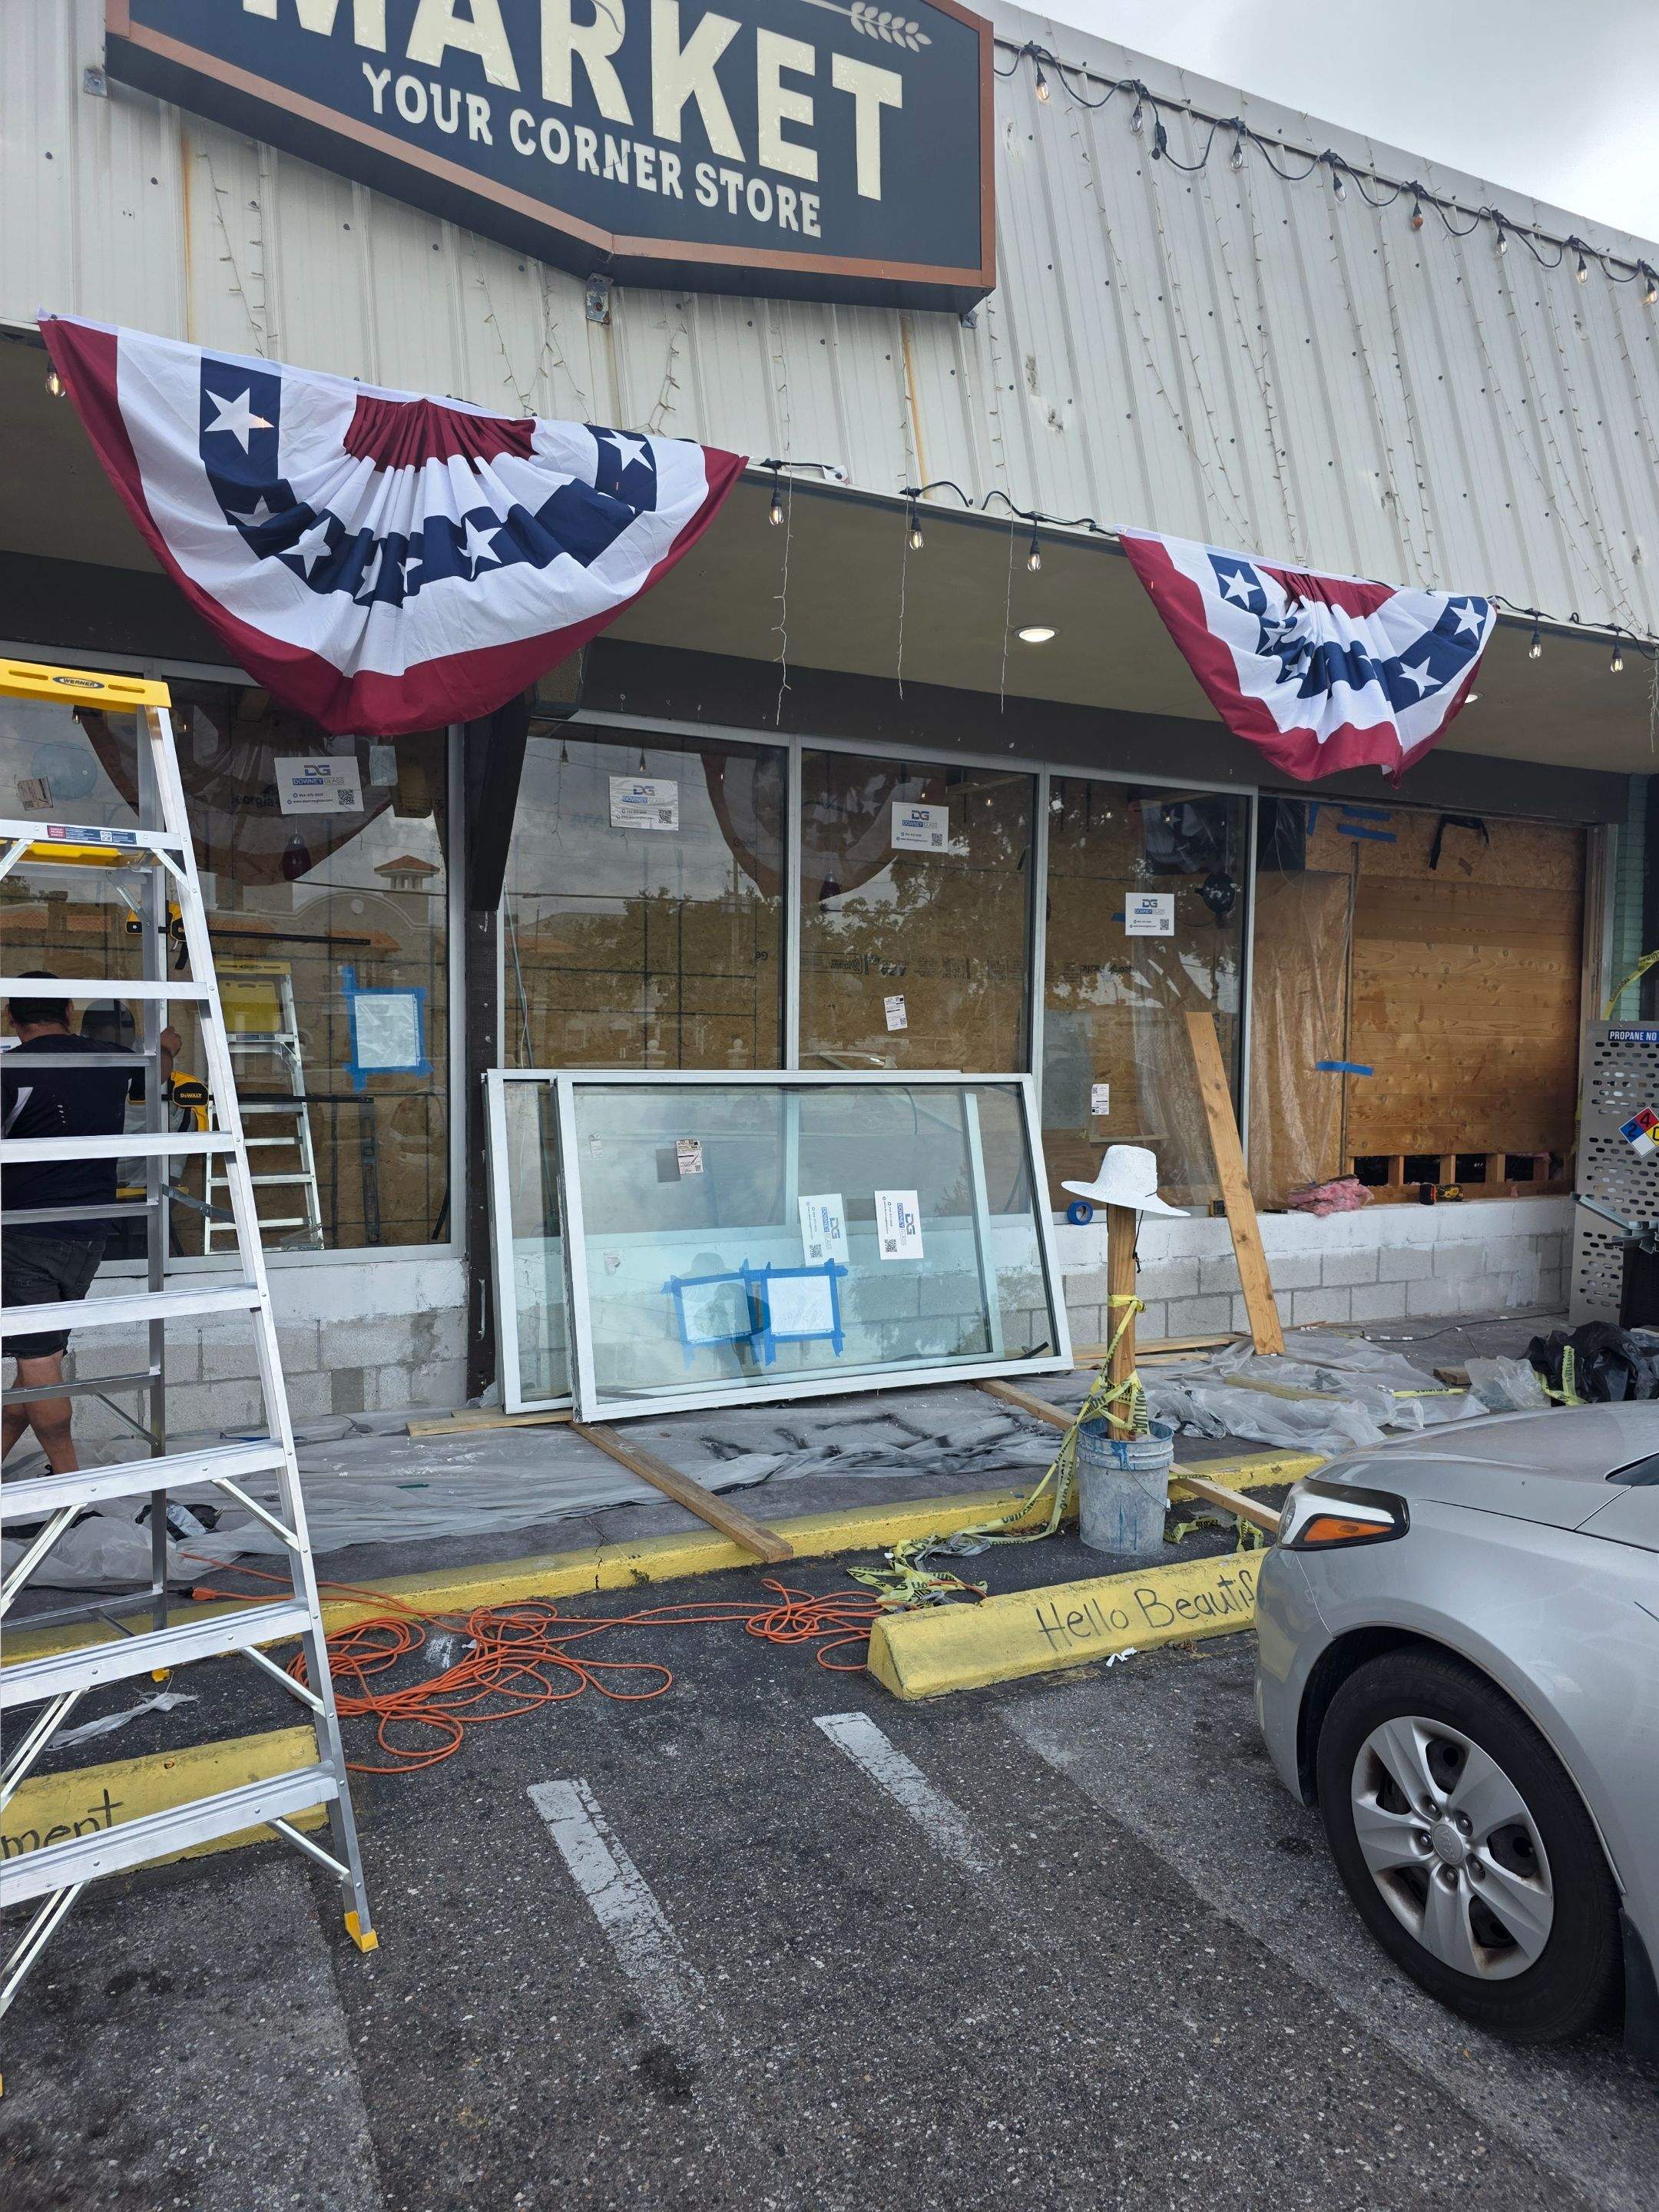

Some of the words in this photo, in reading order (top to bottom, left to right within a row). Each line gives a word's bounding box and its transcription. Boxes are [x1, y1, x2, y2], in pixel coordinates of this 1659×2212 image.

[241, 0, 902, 201] ARKET
[363, 61, 493, 146] YOUR
[510, 108, 684, 200] CORNER
[694, 162, 822, 238] STORE
[63, 678, 96, 687] WERNER
[324, 777, 345, 785] GLASS
[1609, 1031, 1644, 1041] PROPANE
[1645, 1031, 1657, 1041] NO
[1628, 1122, 1638, 1135] 2
[1639, 1112, 1651, 1128] 4
[822, 1207, 830, 1233] DOWNEY
[897, 1202, 906, 1229] DOWNEY
[1036, 1597, 1130, 1652] Hello
